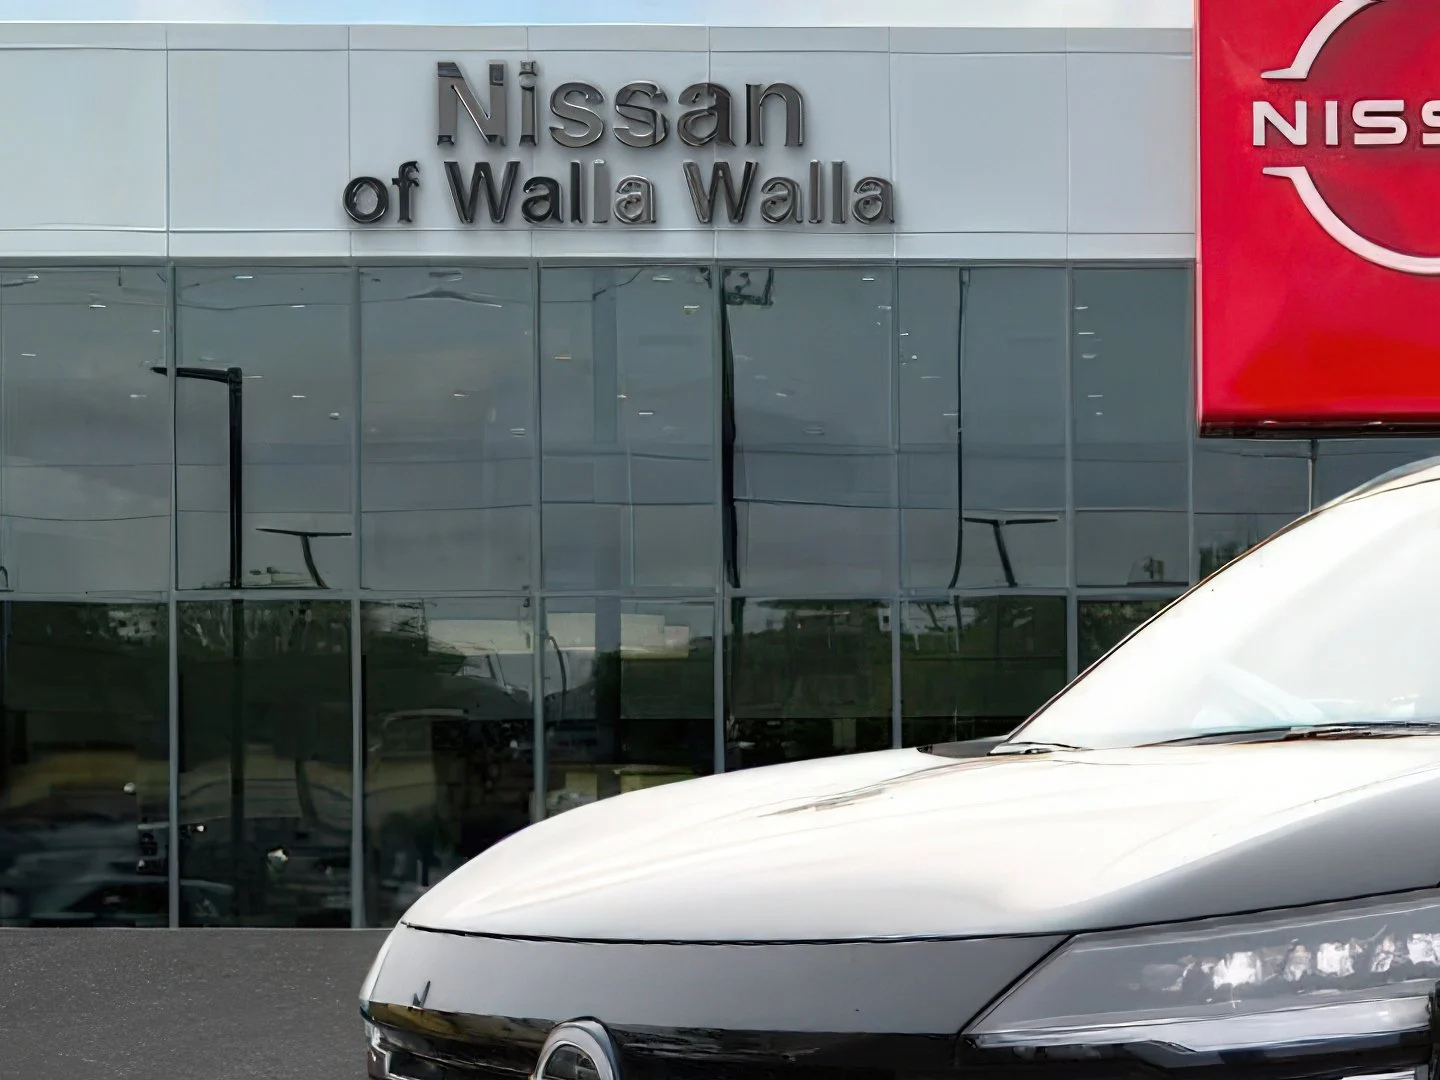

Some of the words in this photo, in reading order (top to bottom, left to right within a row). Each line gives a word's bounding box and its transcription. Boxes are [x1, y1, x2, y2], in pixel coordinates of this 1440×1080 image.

[436, 60, 805, 149] Nissan
[341, 160, 420, 225] of
[443, 159, 657, 225] Walla
[681, 160, 896, 226] Walla
